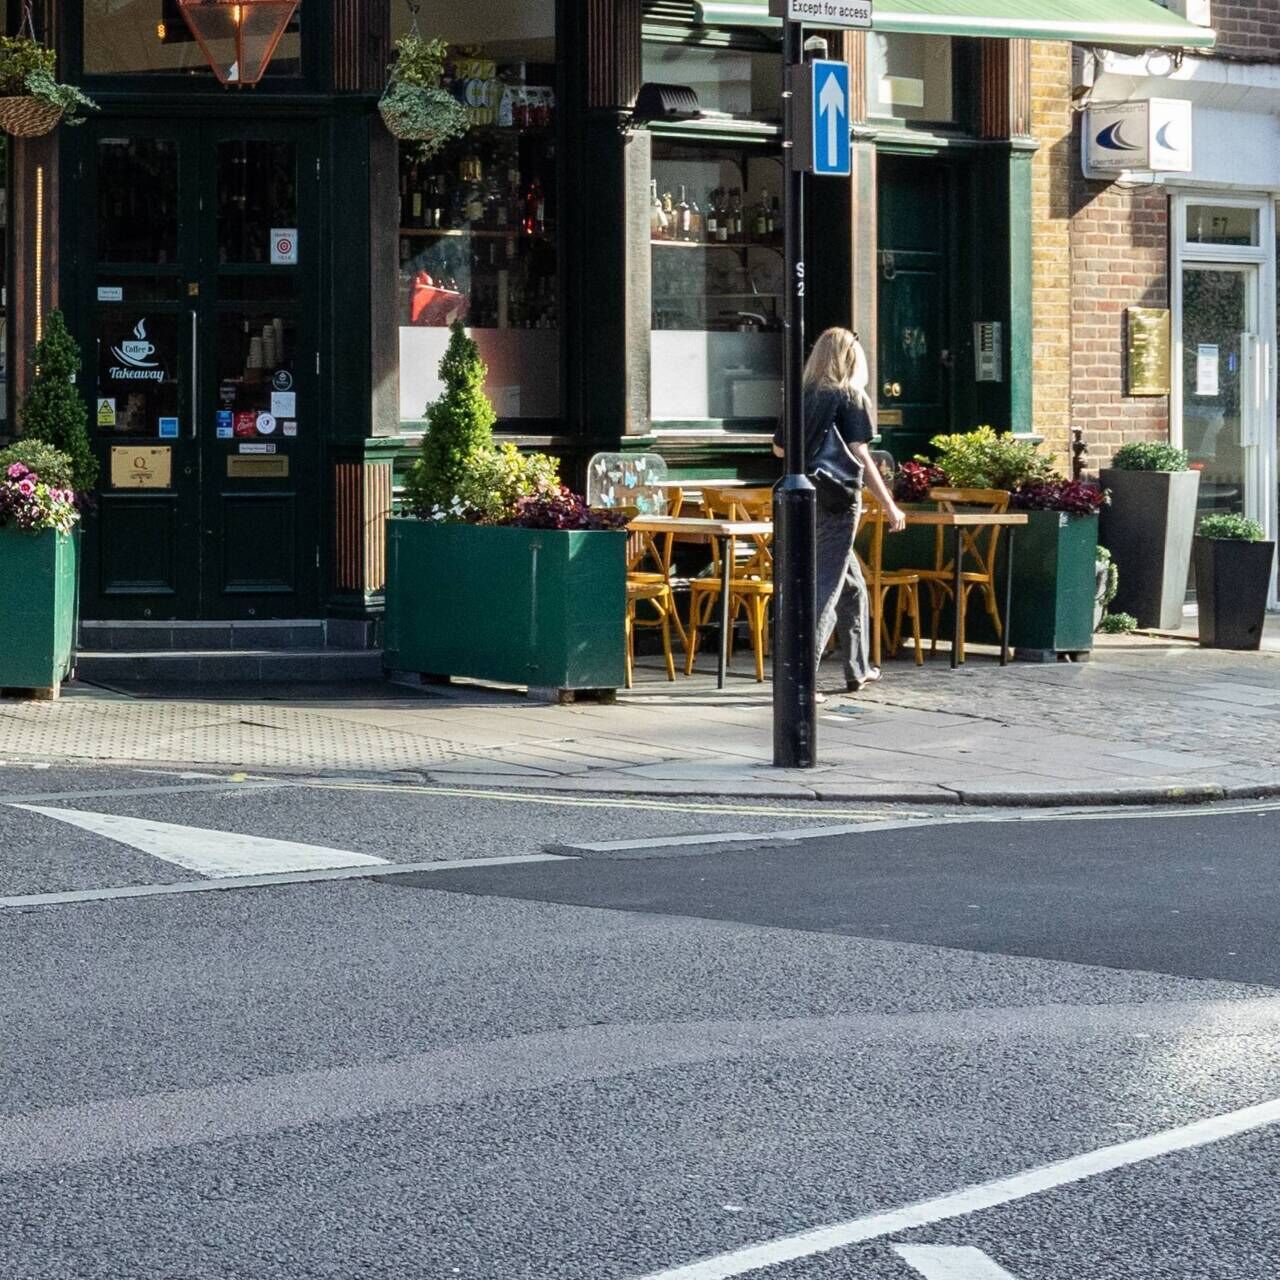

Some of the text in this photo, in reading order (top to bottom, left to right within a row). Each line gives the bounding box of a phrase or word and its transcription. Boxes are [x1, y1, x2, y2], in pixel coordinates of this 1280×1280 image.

[824, 2, 838, 17] for
[839, 6, 869, 19] access
[125, 344, 147, 353] Coffee
[109, 366, 165, 383] Takeaway
